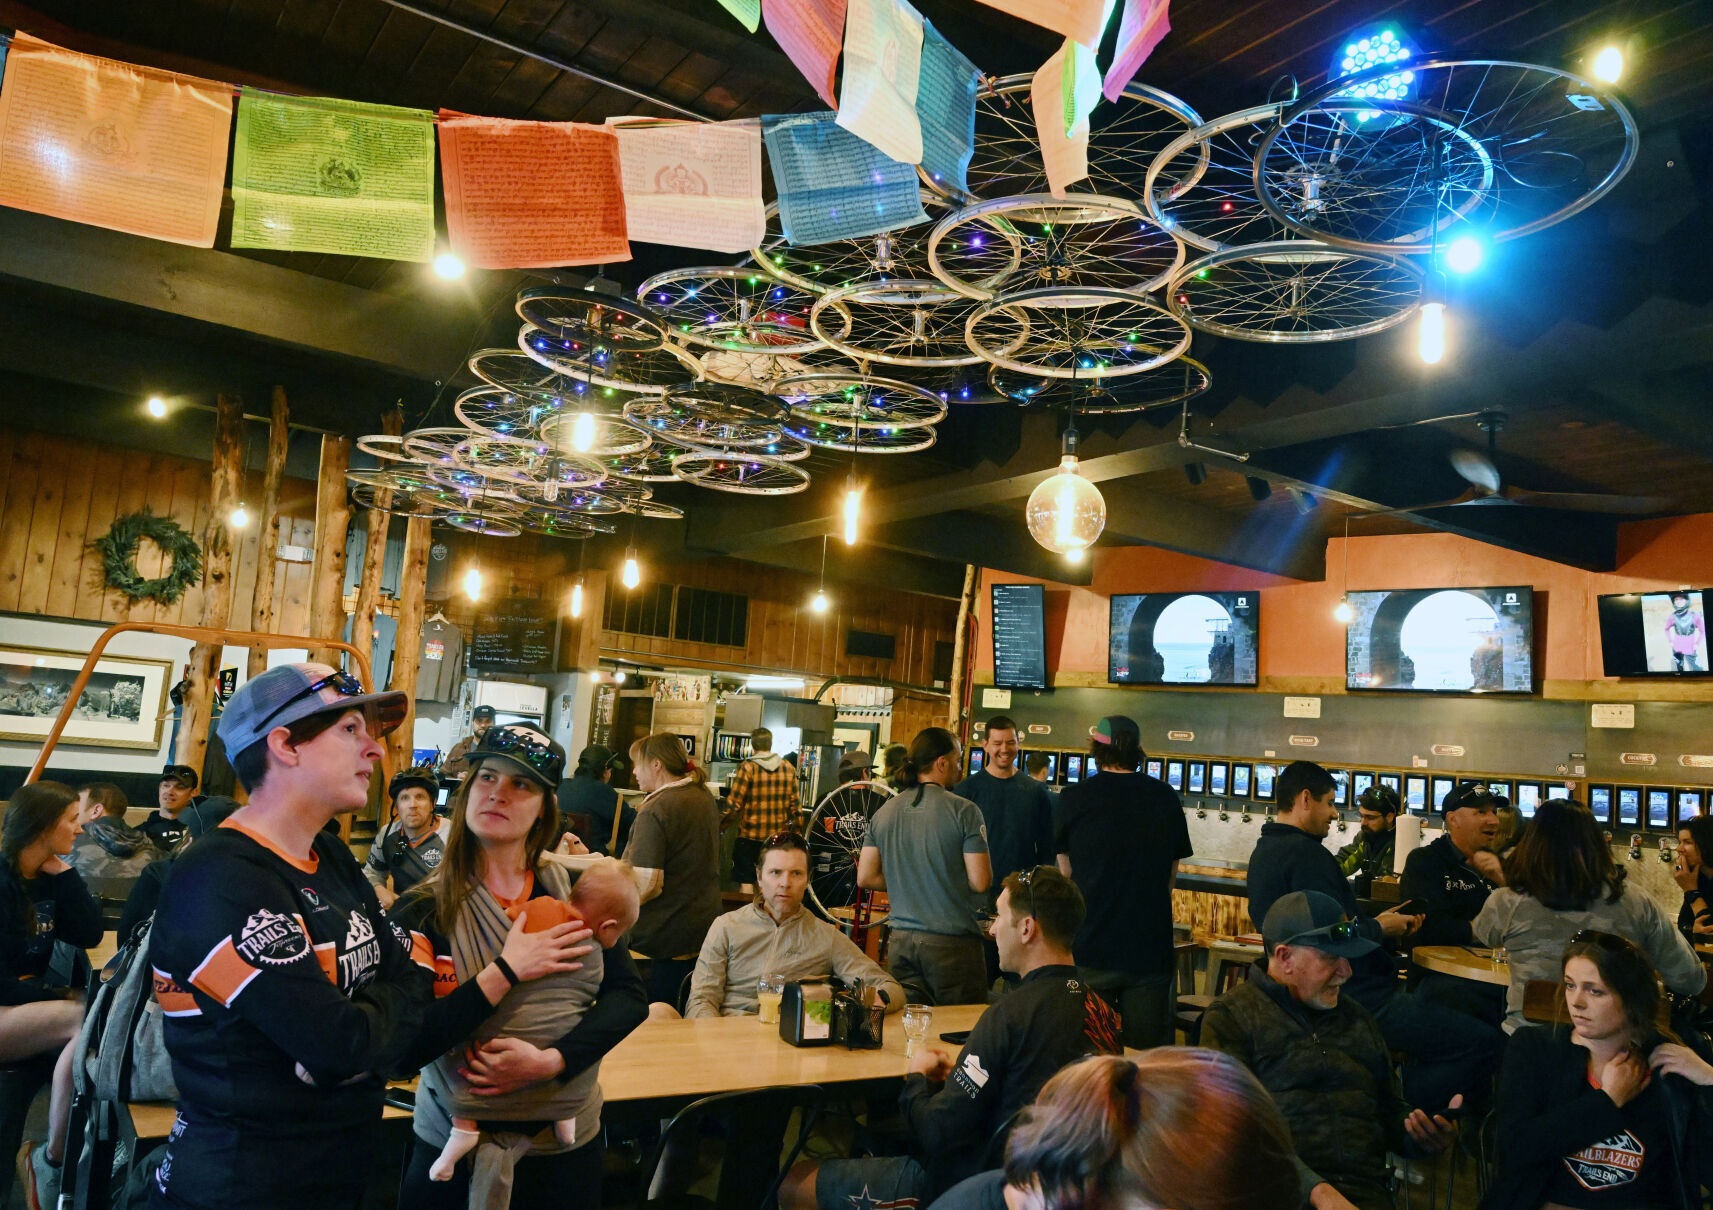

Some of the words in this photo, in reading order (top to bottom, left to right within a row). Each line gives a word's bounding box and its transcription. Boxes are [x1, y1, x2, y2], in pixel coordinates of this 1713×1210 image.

[835, 820, 856, 830] TRAILS
[237, 922, 288, 960] TRAILS
[338, 942, 373, 990] TRAILS
[953, 1072, 976, 1099] TRAILS
[1578, 1164, 1603, 1178] TRAILS
[1602, 1170, 1618, 1184] END
